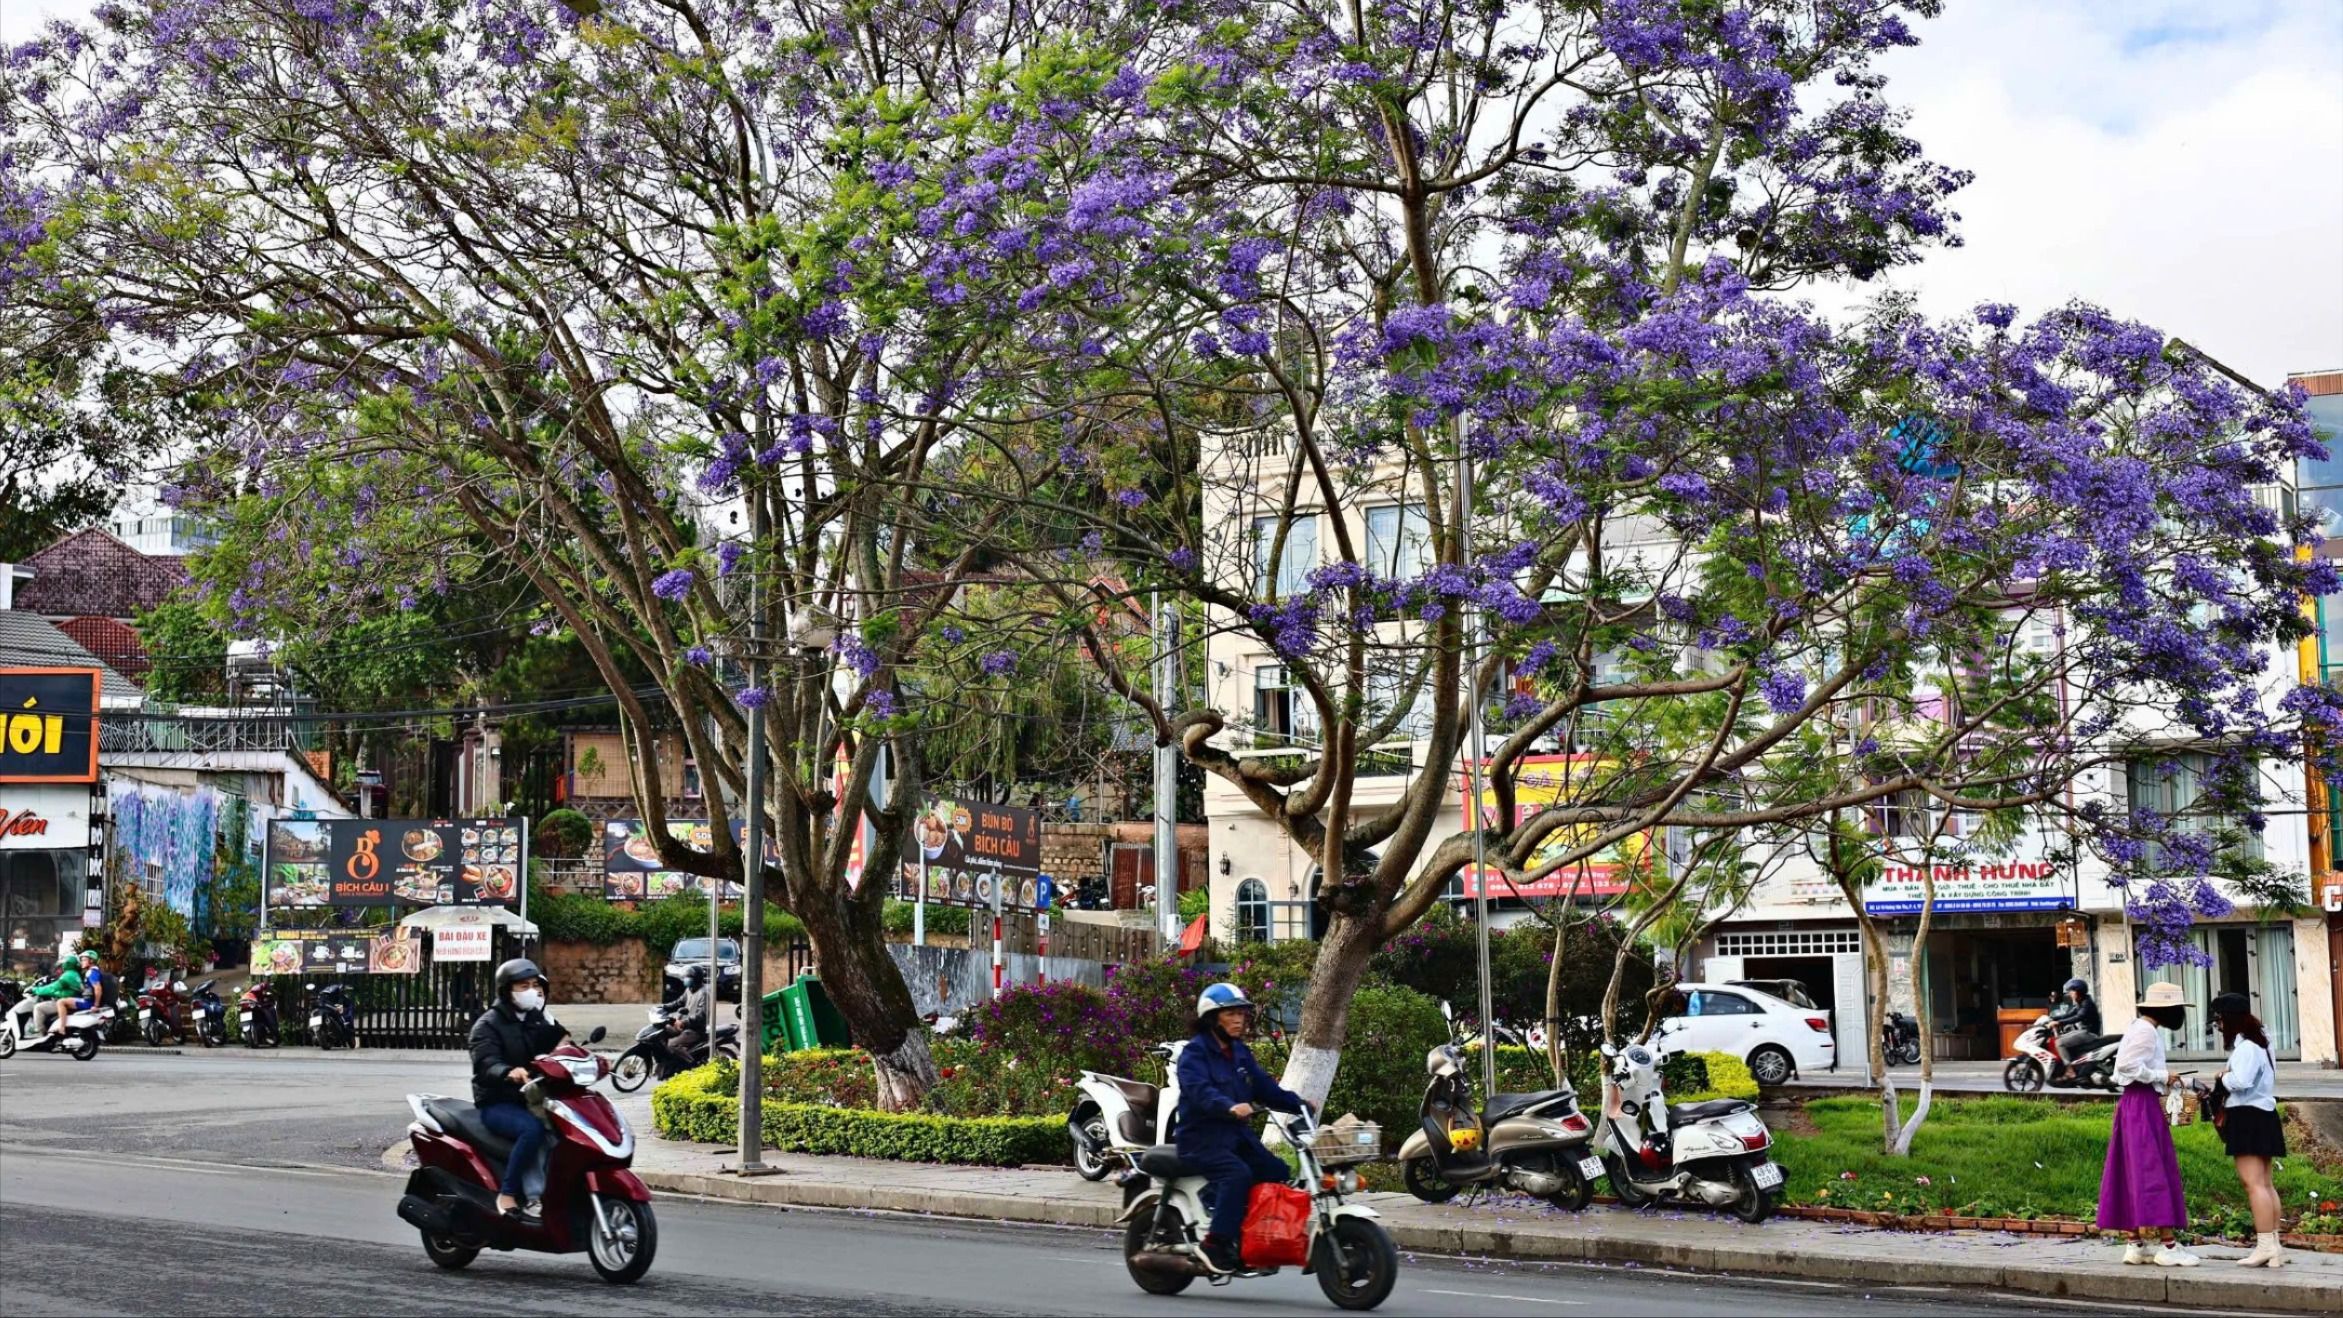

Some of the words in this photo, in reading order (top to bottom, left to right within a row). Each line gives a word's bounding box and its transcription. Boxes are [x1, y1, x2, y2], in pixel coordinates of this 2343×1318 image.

[0, 696, 63, 754] ÓI
[981, 811, 999, 830] BÚN
[1002, 814, 1013, 832] BÒ
[975, 831, 998, 854] BÍCH
[1980, 859, 2056, 881] HƯNG
[336, 881, 360, 892] BÍCH
[1041, 882, 1048, 901] P
